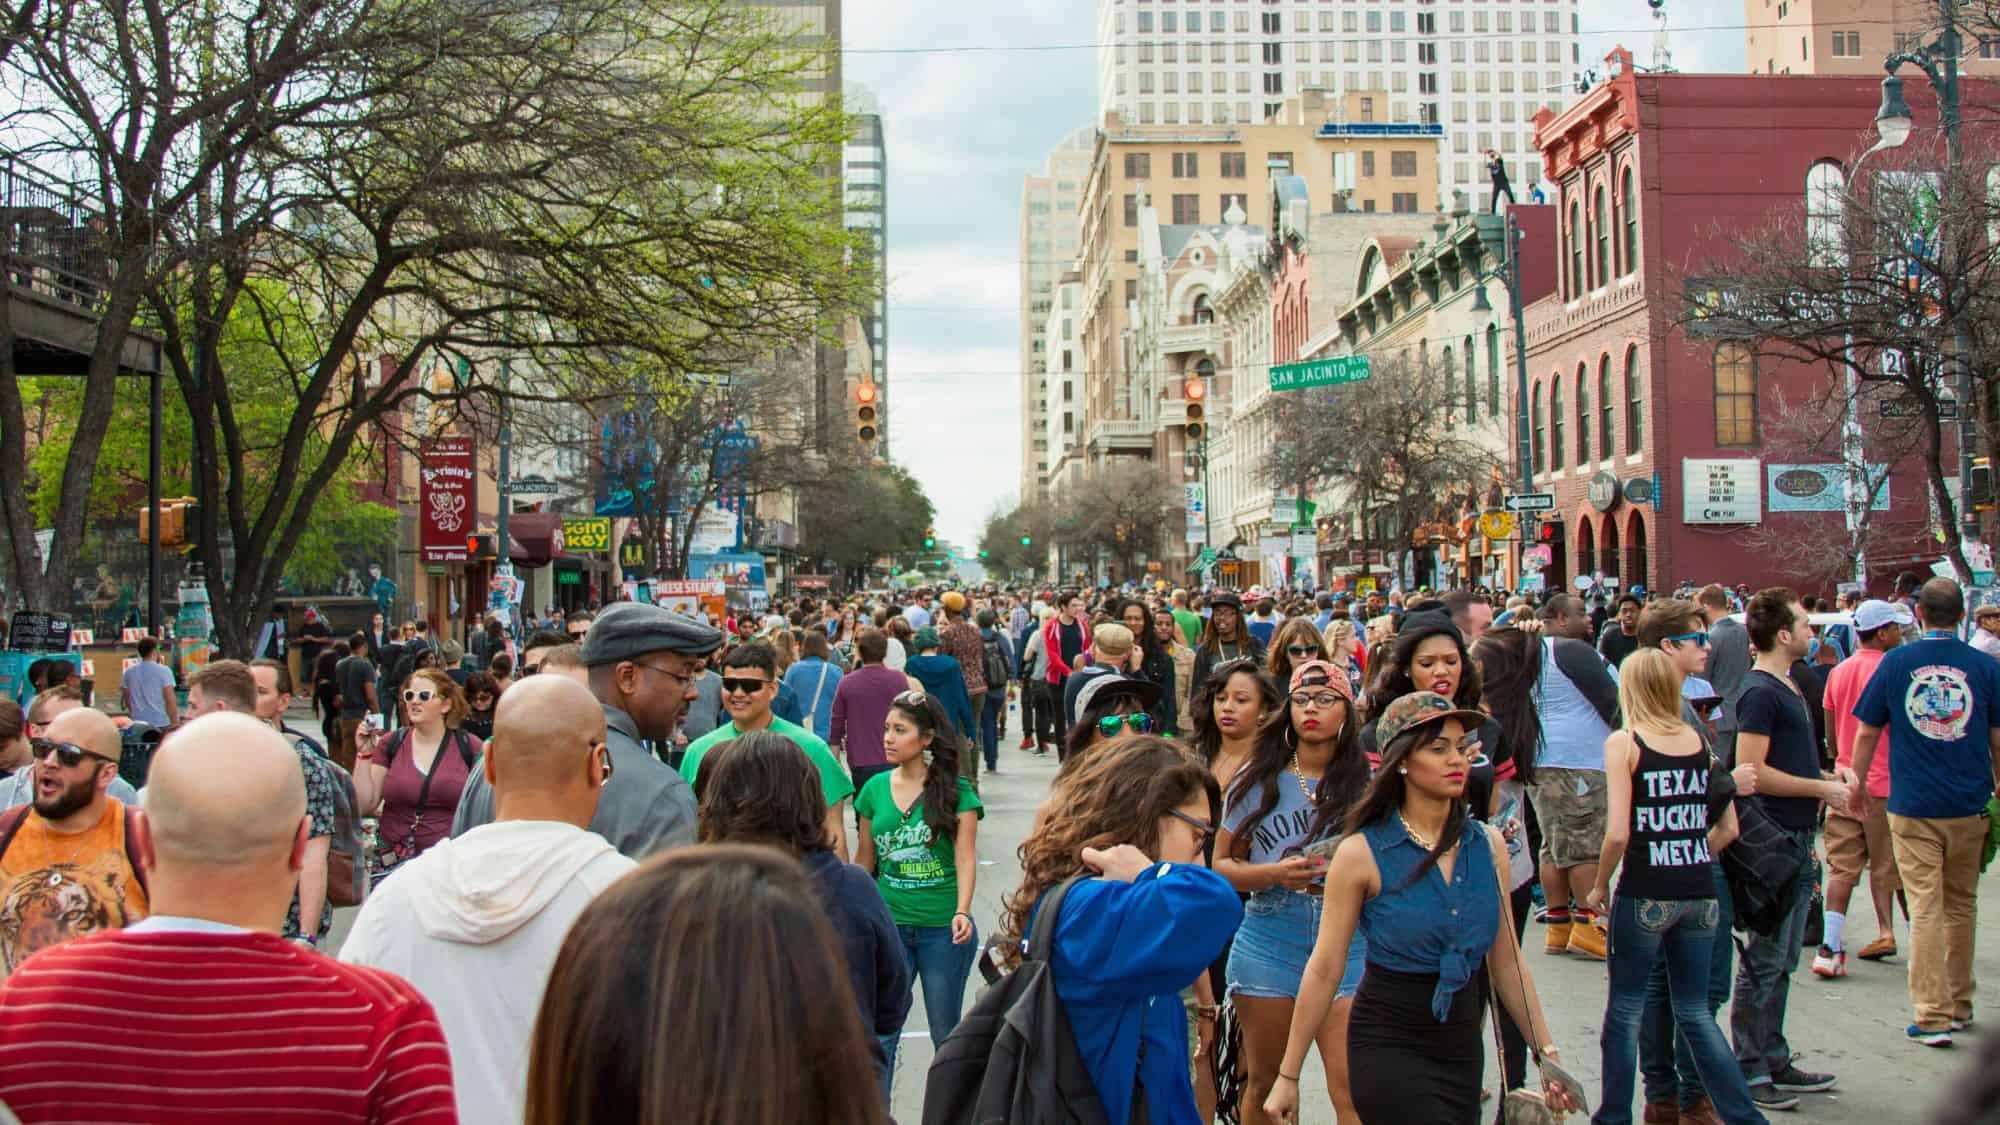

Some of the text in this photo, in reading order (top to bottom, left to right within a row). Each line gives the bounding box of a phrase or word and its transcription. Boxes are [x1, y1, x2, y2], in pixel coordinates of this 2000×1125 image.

[1347, 356, 1369, 366] BLVD
[1271, 363, 1346, 386] SAN JACINTO
[1350, 368, 1369, 380] 600
[1255, 806, 1320, 855] MON
